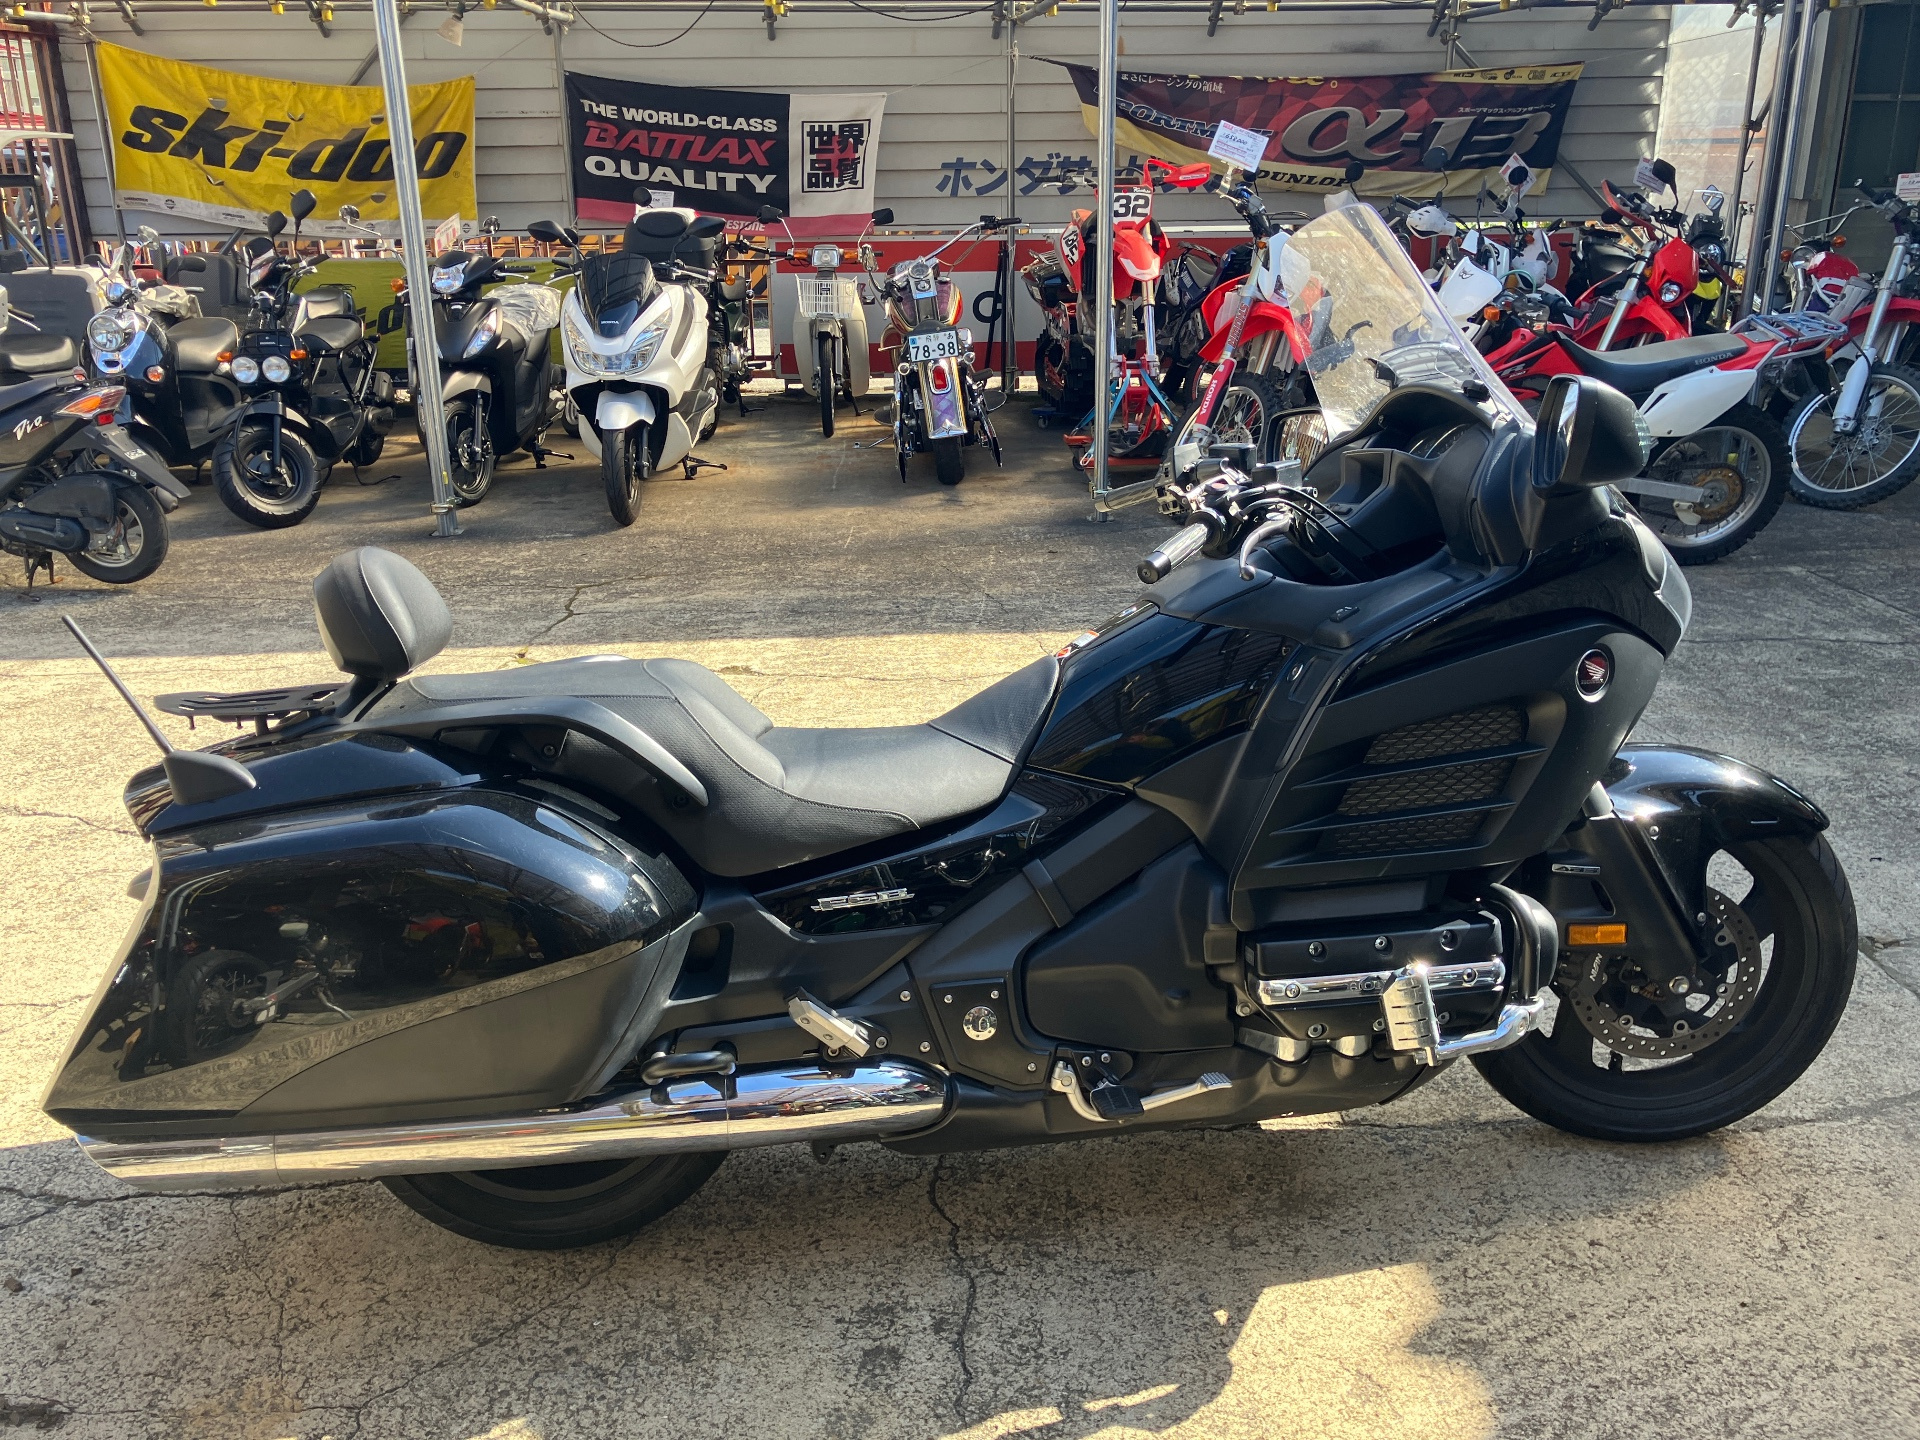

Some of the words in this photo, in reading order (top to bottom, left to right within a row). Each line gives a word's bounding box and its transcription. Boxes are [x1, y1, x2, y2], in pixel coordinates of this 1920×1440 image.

[580, 99, 618, 118] THE
[622, 107, 778, 132] WORLD-CLASS
[1093, 90, 1274, 138] PORTM
[121, 104, 468, 182] ski-doo
[584, 120, 777, 166] BATTLAX
[806, 124, 865, 154] 世界
[584, 156, 778, 194] QUALITY
[806, 158, 862, 189] 品質
[725, 219, 766, 231] ESTONE
[911, 341, 956, 361] 78-98
[1694, 352, 1734, 365] HONDA
[1199, 379, 1218, 416] HONDA
